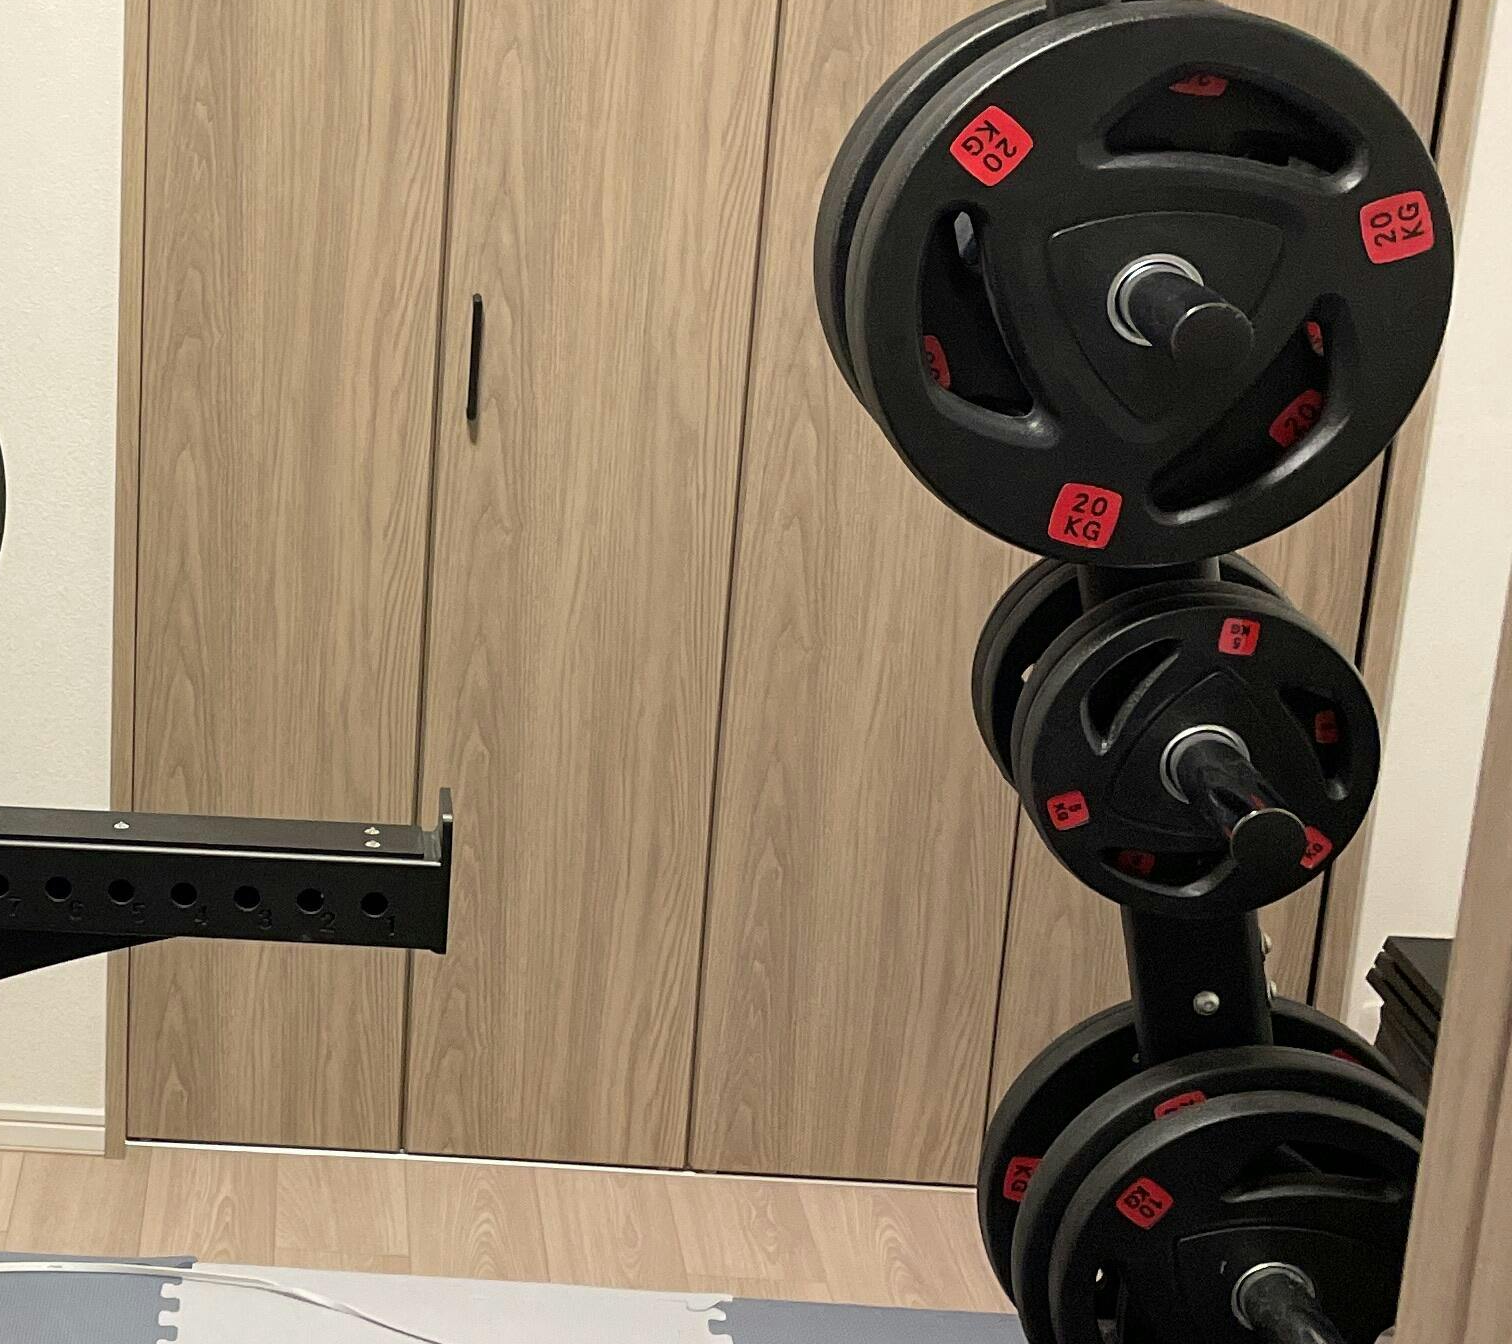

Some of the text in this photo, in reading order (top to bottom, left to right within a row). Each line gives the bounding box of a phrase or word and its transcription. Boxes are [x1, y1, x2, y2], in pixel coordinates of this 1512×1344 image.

[961, 119, 1001, 157] KG
[982, 137, 1017, 173] 20
[1370, 212, 1397, 248] 20
[1397, 201, 1425, 240] KG
[1071, 492, 1108, 517] 20
[1063, 515, 1102, 542] KG
[1230, 623, 1251, 637] KG
[1232, 636, 1242, 650] 5
[8, 897, 22, 918] 7
[257, 908, 272, 931] 3
[320, 911, 336, 934] 2
[387, 914, 396, 938] 1
[1010, 1165, 1033, 1193] KG
[1123, 1185, 1151, 1210] KG
[1139, 1197, 1163, 1219] 10
